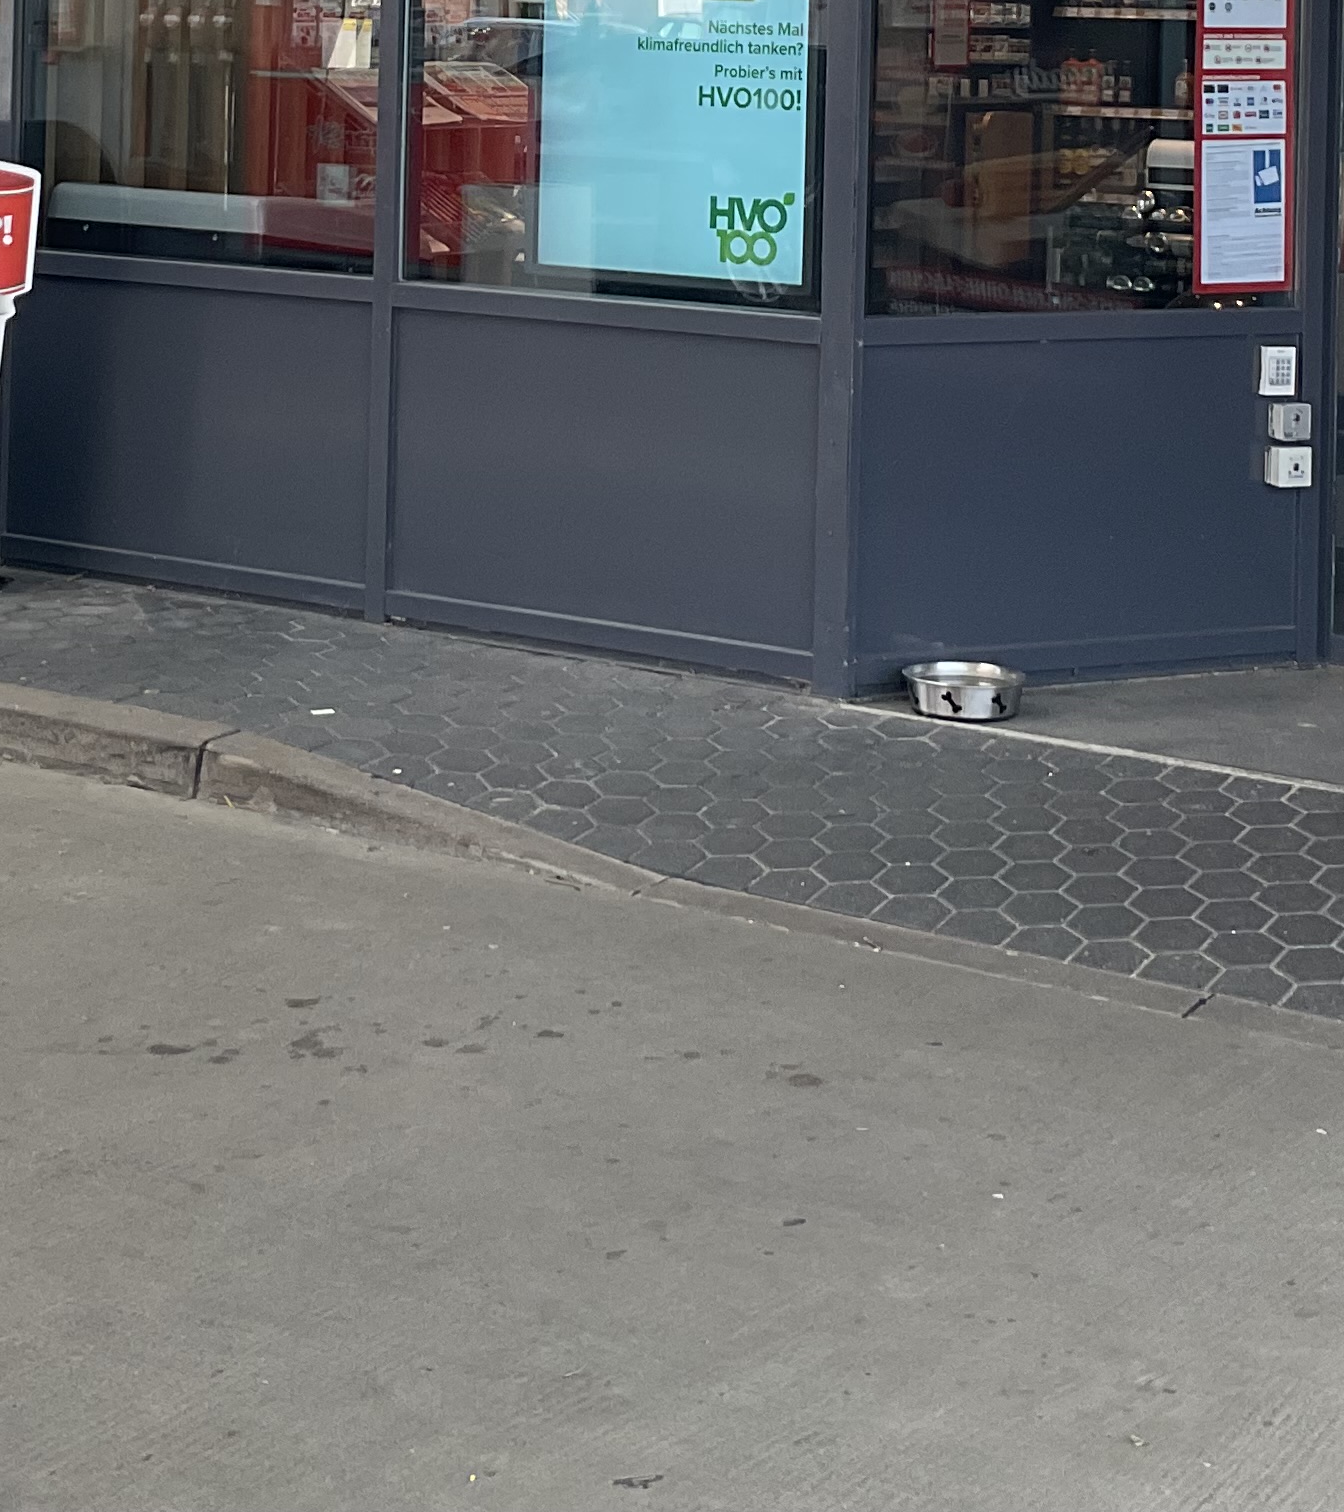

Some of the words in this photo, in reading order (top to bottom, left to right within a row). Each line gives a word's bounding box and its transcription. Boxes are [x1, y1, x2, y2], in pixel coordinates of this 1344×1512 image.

[708, 20, 774, 36] Nächstes
[777, 21, 804, 36] Mal
[637, 37, 744, 54] klimafreundlich
[747, 42, 804, 56] tanken?
[780, 66, 803, 80] mit
[698, 86, 802, 111] HVO100!
[709, 195, 788, 234] HVO
[716, 229, 778, 266] 100
